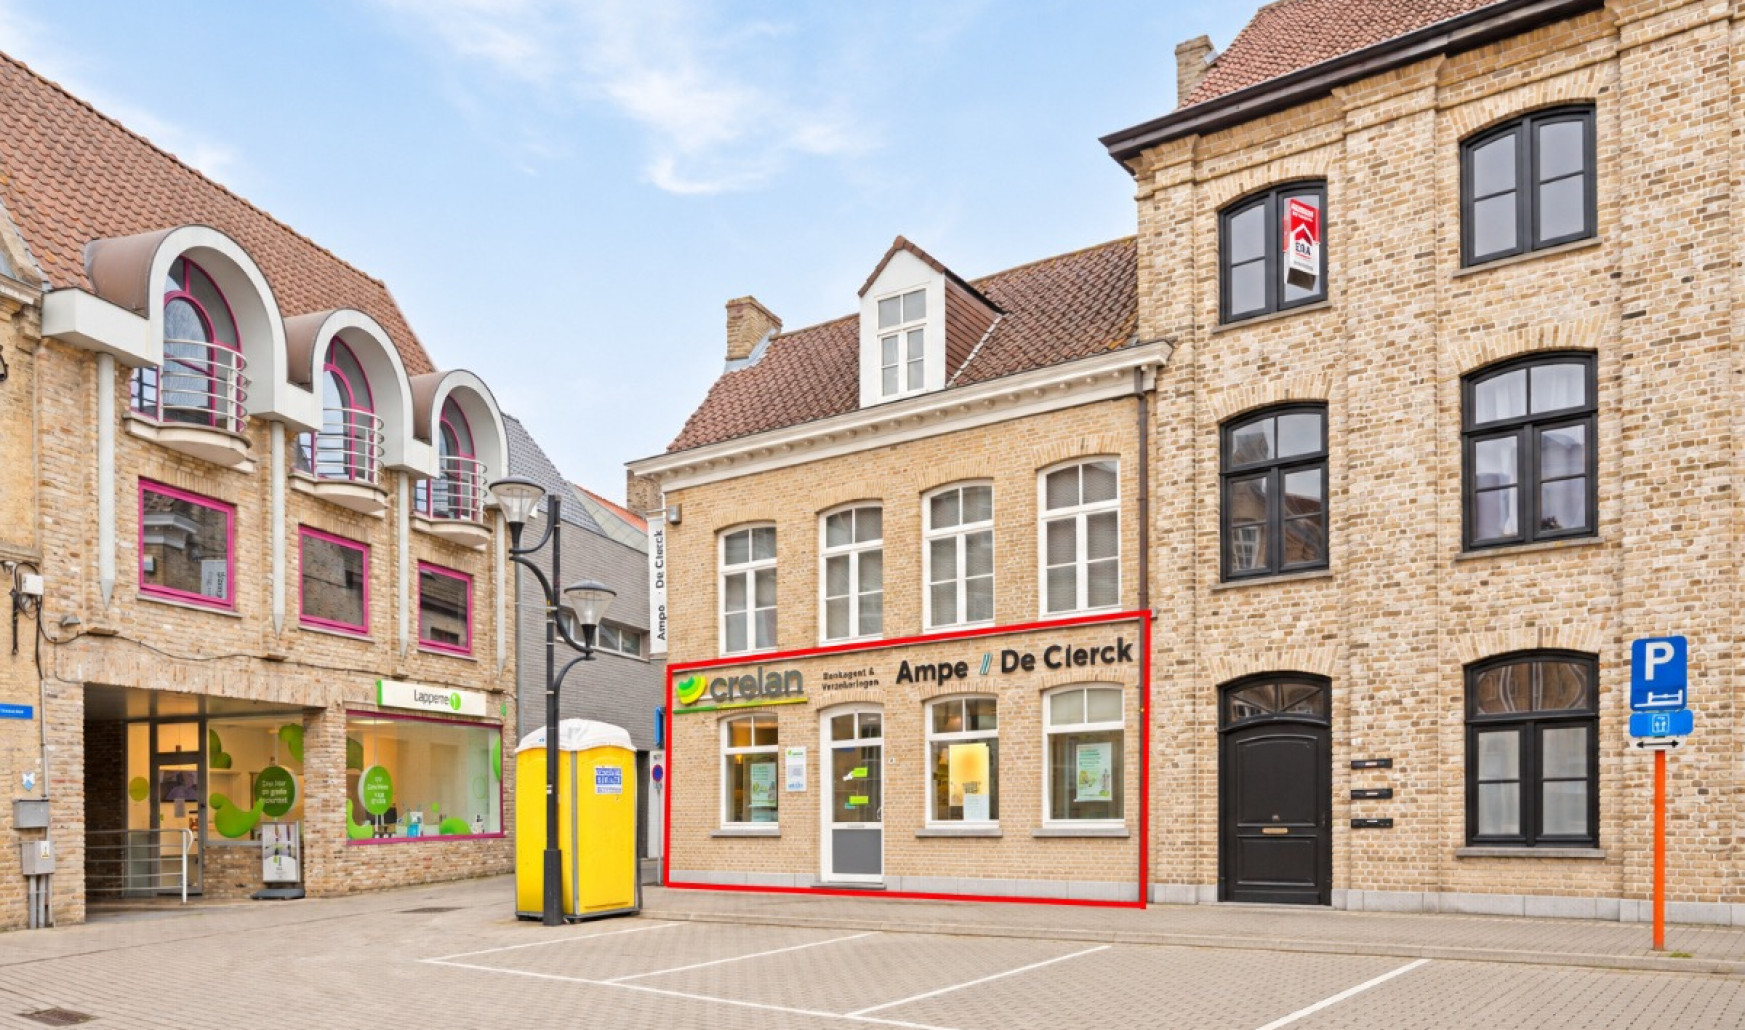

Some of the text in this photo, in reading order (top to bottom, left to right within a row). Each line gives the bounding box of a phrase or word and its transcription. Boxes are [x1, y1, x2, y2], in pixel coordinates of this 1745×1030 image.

[896, 659, 969, 686] Ampe
[1001, 649, 1036, 673] De
[1044, 636, 1134, 669] Clerck
[1645, 642, 1675, 681] P
[710, 666, 804, 702] crelan
